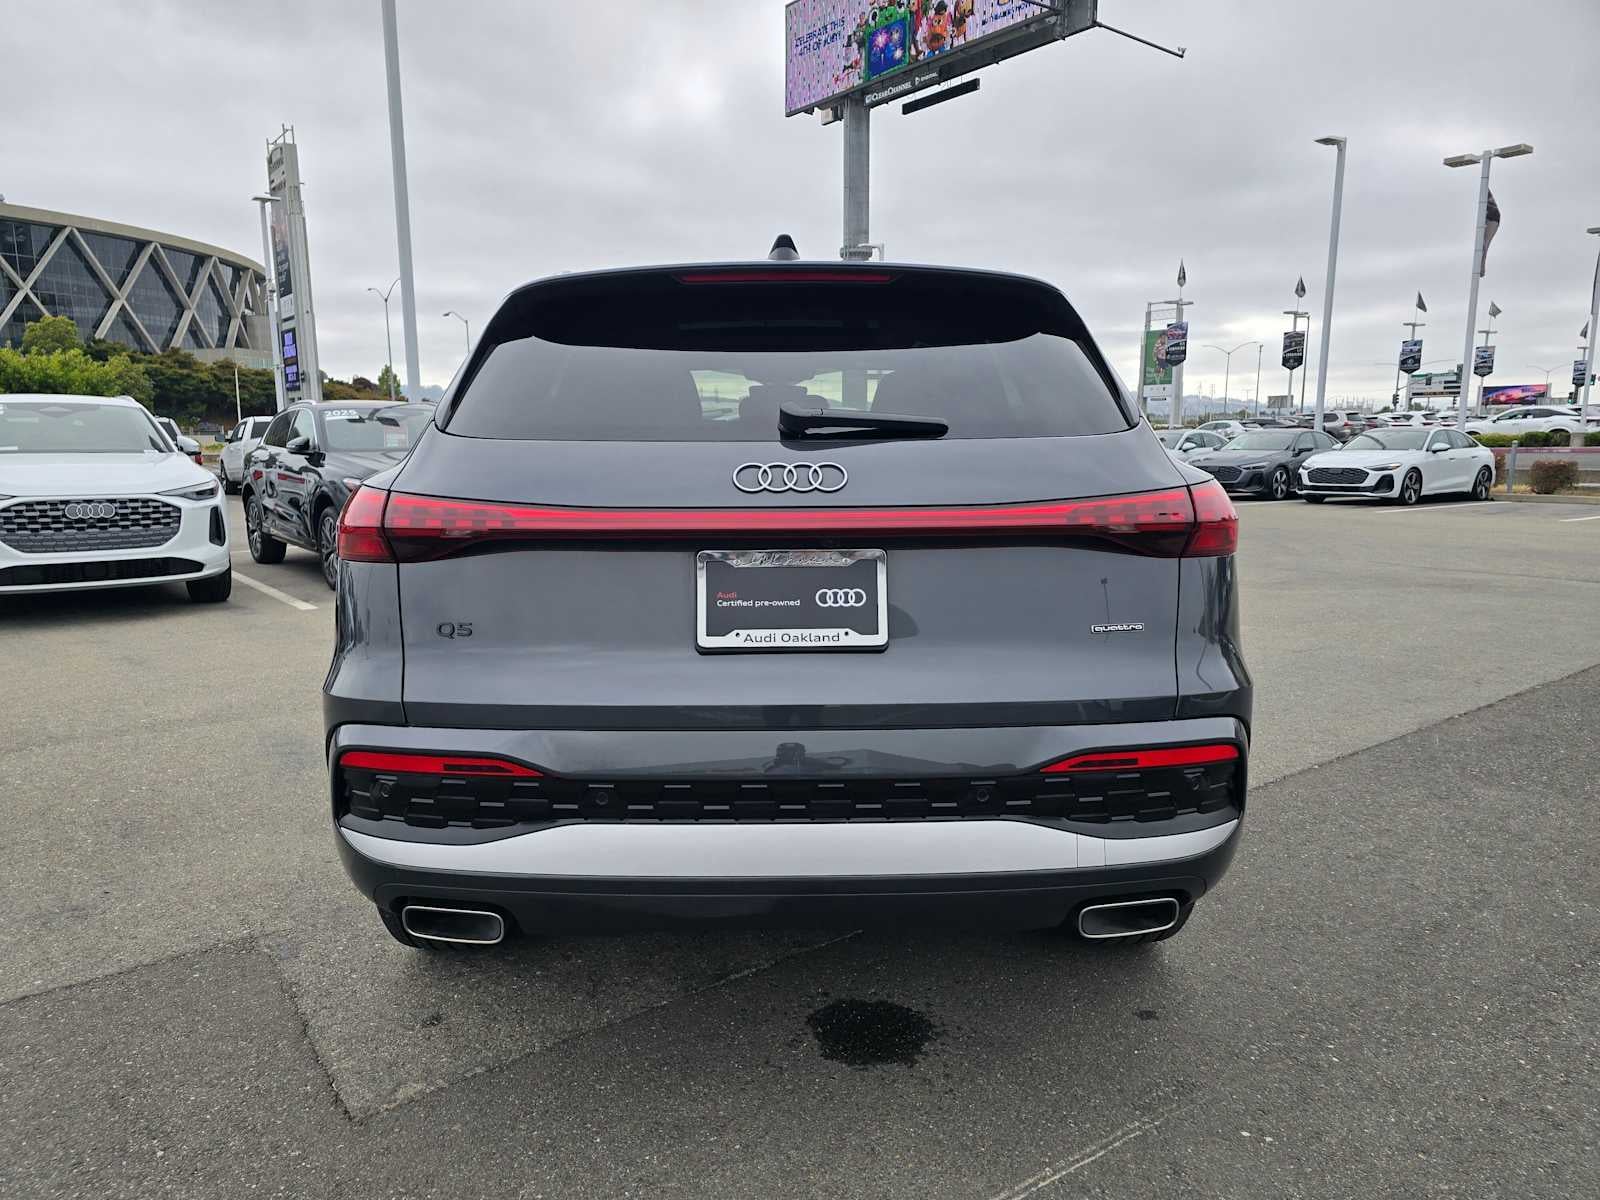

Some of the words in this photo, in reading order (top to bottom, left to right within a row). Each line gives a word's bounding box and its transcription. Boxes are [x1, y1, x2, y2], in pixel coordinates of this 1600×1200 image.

[324, 409, 357, 417] 2025
[716, 599, 754, 607] Certified
[755, 599, 801, 607] pre-owned
[438, 622, 473, 640] Q5
[1091, 623, 1145, 634] quattro
[743, 632, 777, 643] Audi
[780, 632, 841, 643] Oakland
